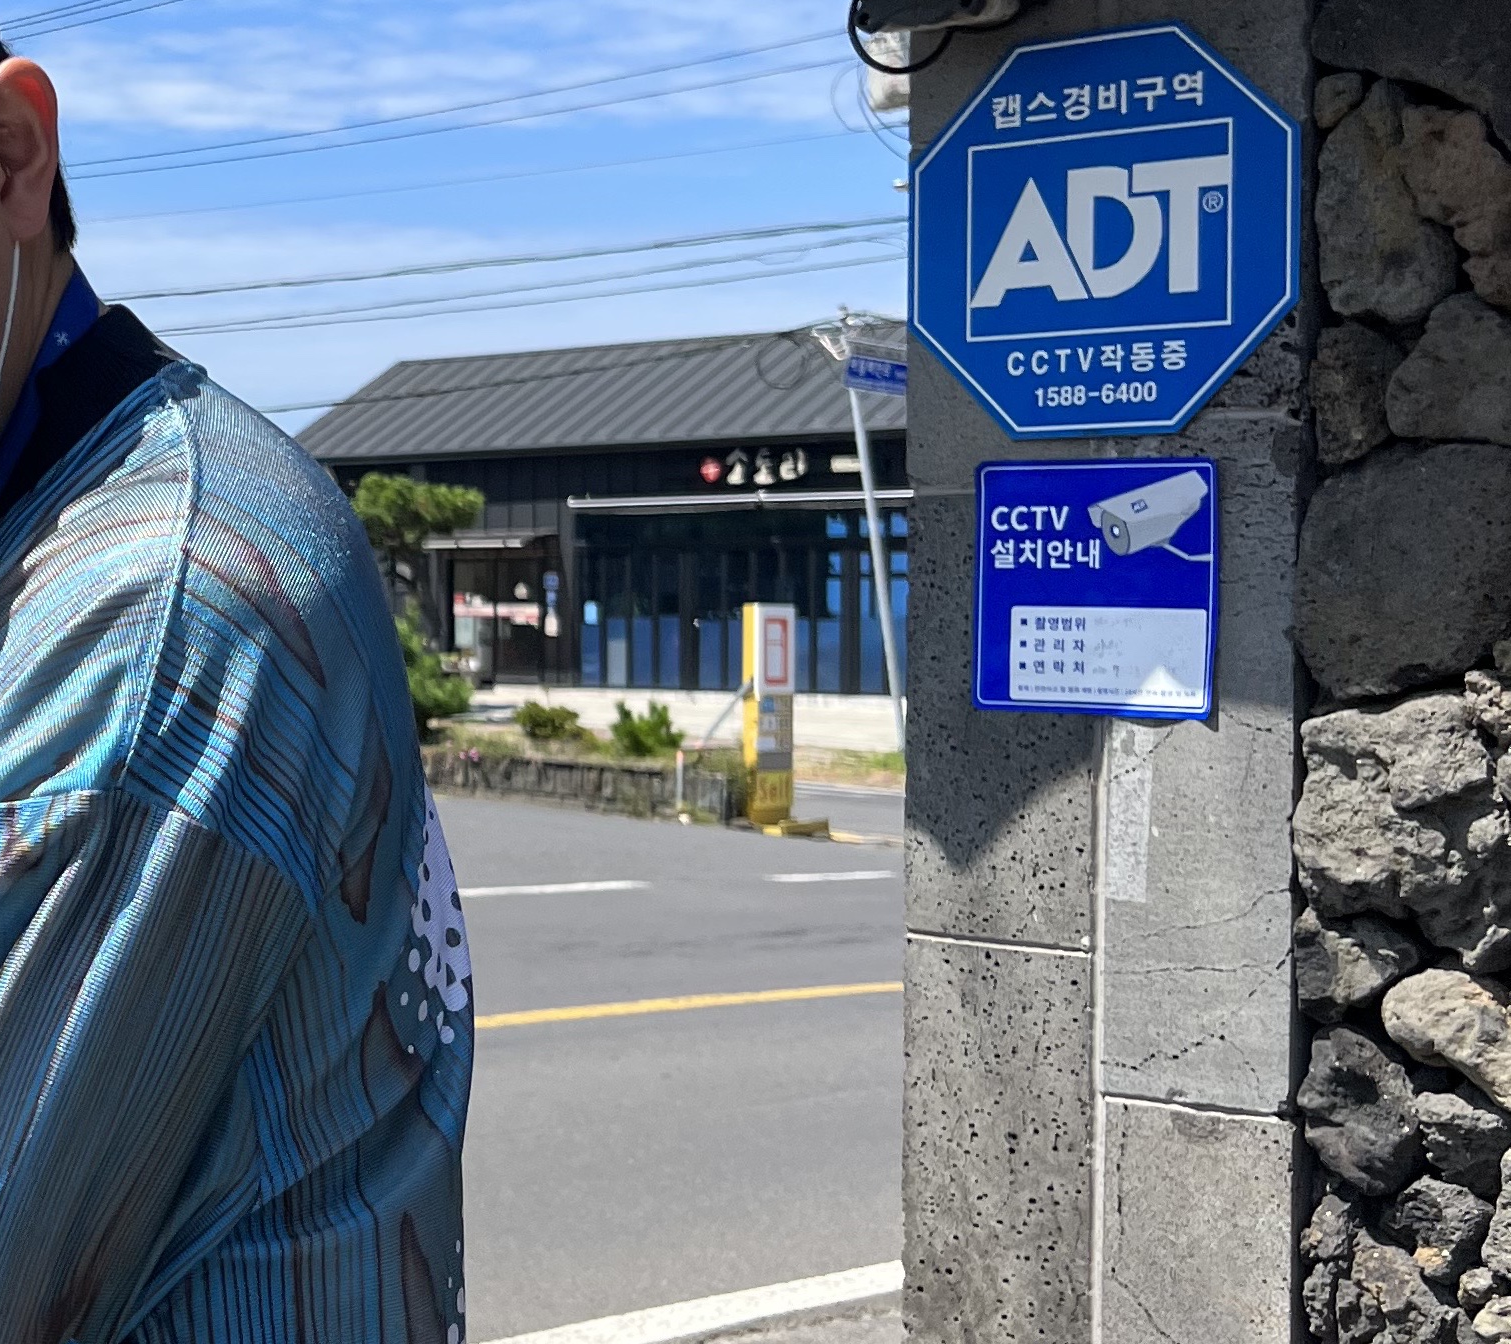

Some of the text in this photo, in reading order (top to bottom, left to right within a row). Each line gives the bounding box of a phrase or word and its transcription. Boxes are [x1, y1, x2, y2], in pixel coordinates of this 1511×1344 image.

[991, 70, 1204, 130] 캡스경비구역
[969, 155, 1232, 308] ADT
[1034, 381, 1158, 407] 1588-6400
[990, 505, 1069, 532] CCTV
[990, 538, 1101, 570] 설치안내
